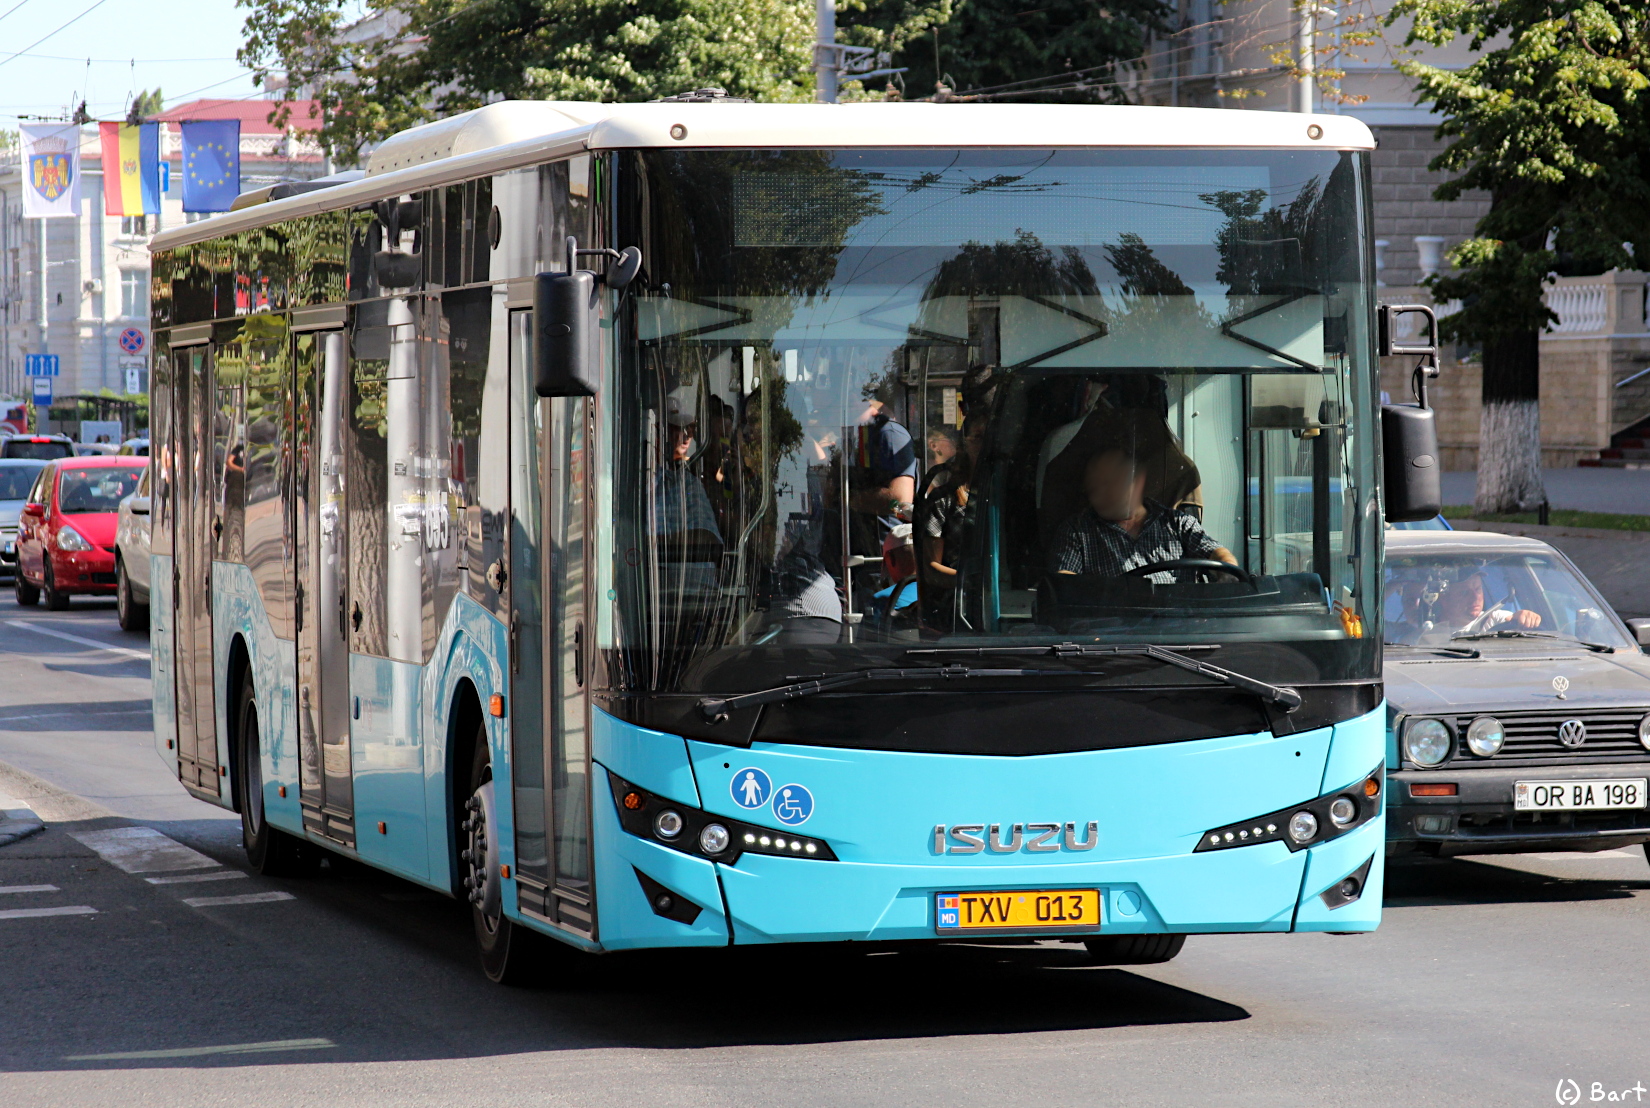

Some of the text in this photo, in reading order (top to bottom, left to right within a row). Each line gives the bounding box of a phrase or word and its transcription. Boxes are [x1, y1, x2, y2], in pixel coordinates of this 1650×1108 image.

[1560, 719, 1586, 748] VW
[1534, 784, 1637, 806] OR BA 198
[934, 820, 1099, 854] ISUZU
[941, 912, 956, 924] MD
[961, 895, 1083, 923] TXV 013
